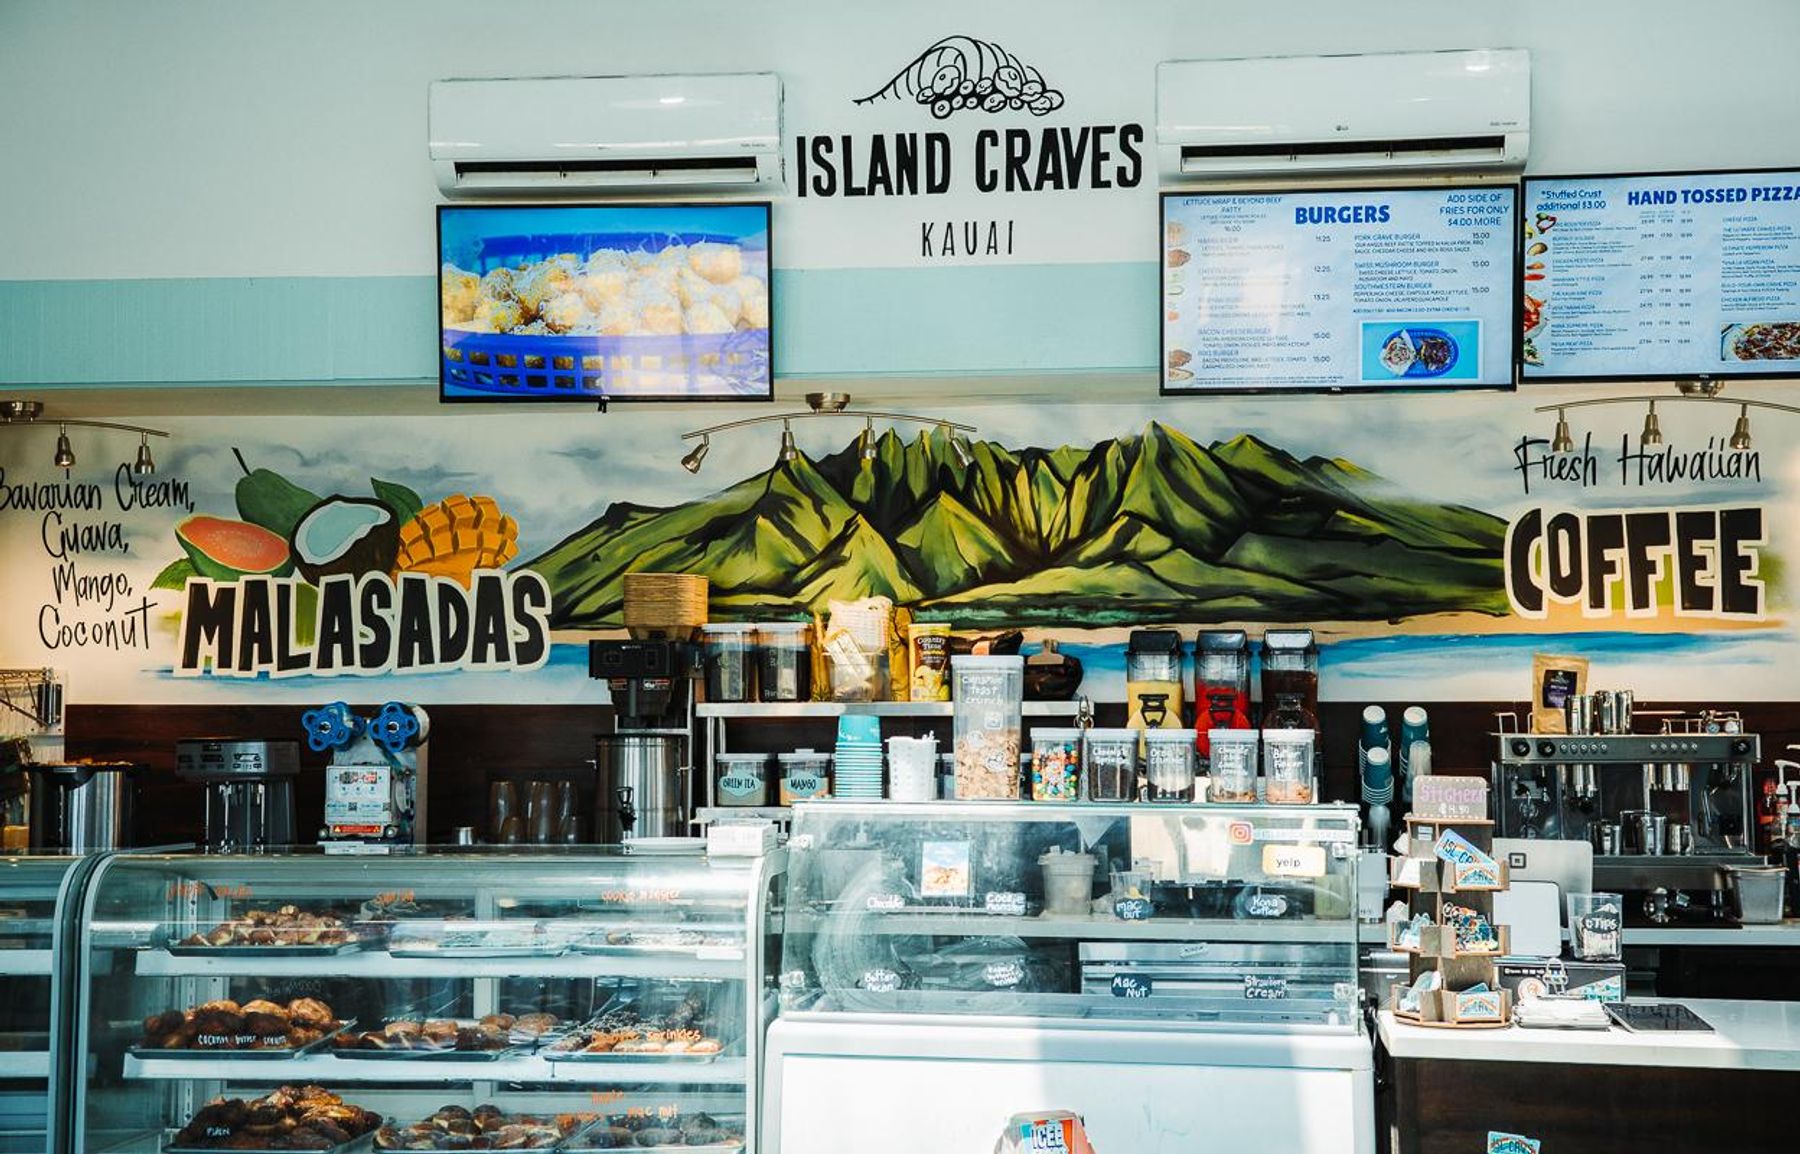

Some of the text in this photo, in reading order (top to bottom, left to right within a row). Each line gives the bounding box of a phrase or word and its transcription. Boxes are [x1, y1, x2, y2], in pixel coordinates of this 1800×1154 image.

[797, 123, 1144, 198] ISLAND CRAVES
[1447, 193, 1503, 203] ADD SIDE OF
[1578, 189, 1602, 198] Crust
[1627, 189, 1678, 206] HAND
[1680, 187, 1748, 204] TOSSED
[1440, 205, 1510, 215] FRIES FOR ONLY
[1536, 200, 1606, 211] additional $3.00
[1295, 204, 1391, 225] BURGERS
[1448, 216, 1502, 227] $4.00 MORE
[920, 220, 1015, 258] KAUAI
[1513, 431, 1761, 494] Fresh Hawaiian
[0, 463, 195, 513] Bavarian Cream,
[42, 510, 129, 562] Guava,
[1508, 505, 1764, 616] COFFEE
[52, 561, 132, 612] Mango,
[39, 596, 158, 651] Coconut
[178, 571, 549, 673] MALASADAS
[723, 779, 743, 788] GREEN
[790, 779, 817, 790] MANGO
[1276, 858, 1301, 868] yelp
[1252, 896, 1278, 907] Kona
[1250, 905, 1280, 916] Coffee
[1112, 977, 1137, 988] Mac
[1126, 986, 1147, 998] Nut
[1032, 1122, 1064, 1149] ICEE
